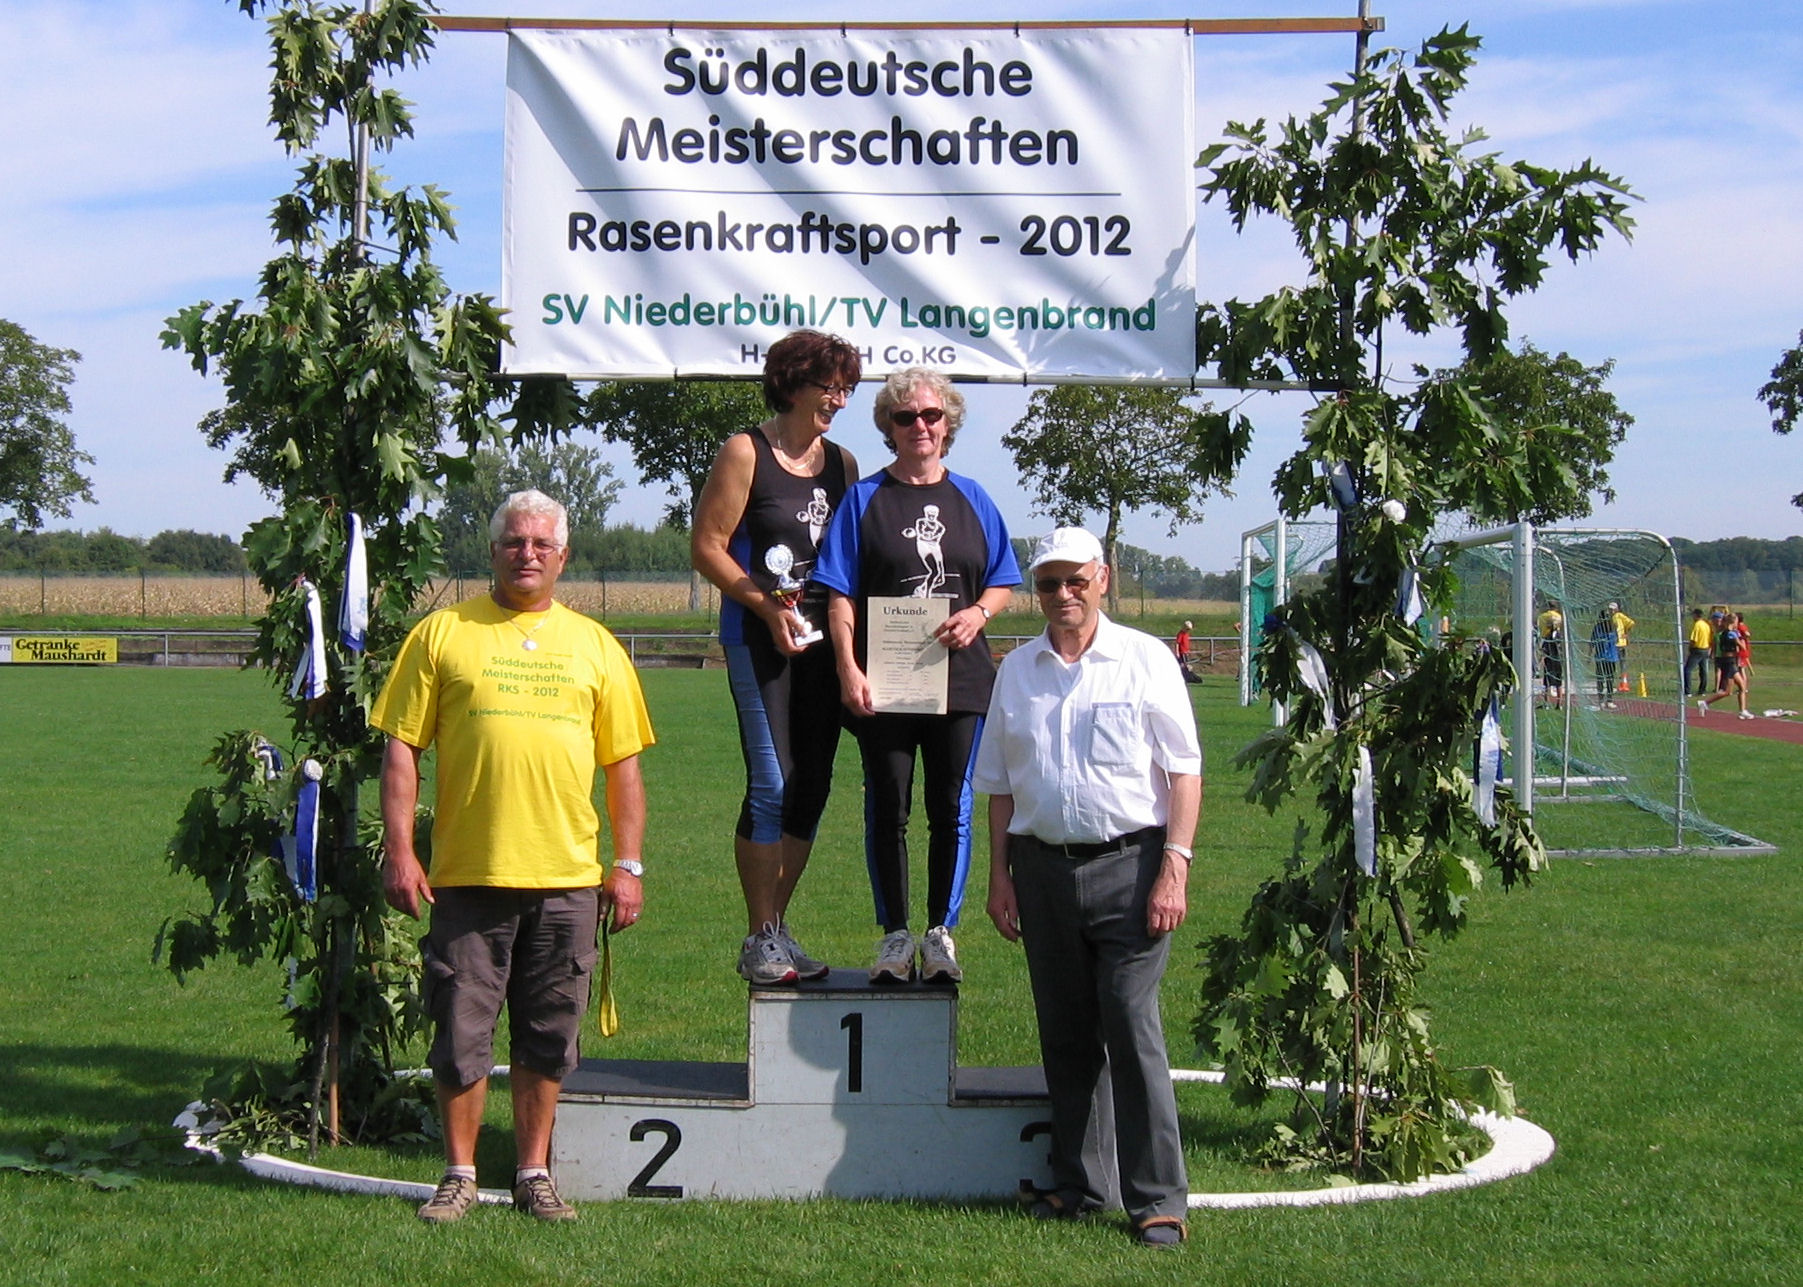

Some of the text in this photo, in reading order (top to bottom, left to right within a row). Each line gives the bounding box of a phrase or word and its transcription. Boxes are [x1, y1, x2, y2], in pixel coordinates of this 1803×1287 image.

[663, 47, 1033, 97] Süddeutsche
[615, 113, 1079, 166] Meisterschaften
[567, 210, 962, 266] Rasenkraftsport
[1019, 214, 1132, 257] 2012
[541, 292, 1156, 338] SV Niederbühl/TV Langenbrand
[882, 345, 957, 365] Co.KG
[883, 606, 928, 616] Urkunde
[31, 649, 107, 661] Maushardt
[491, 656, 564, 670] Süddeutsche
[482, 669, 575, 684] Meisterschaften
[497, 683, 520, 695] RKS
[532, 686, 560, 697] 2012
[840, 1012, 863, 1093] 1
[627, 1118, 684, 1199] 2
